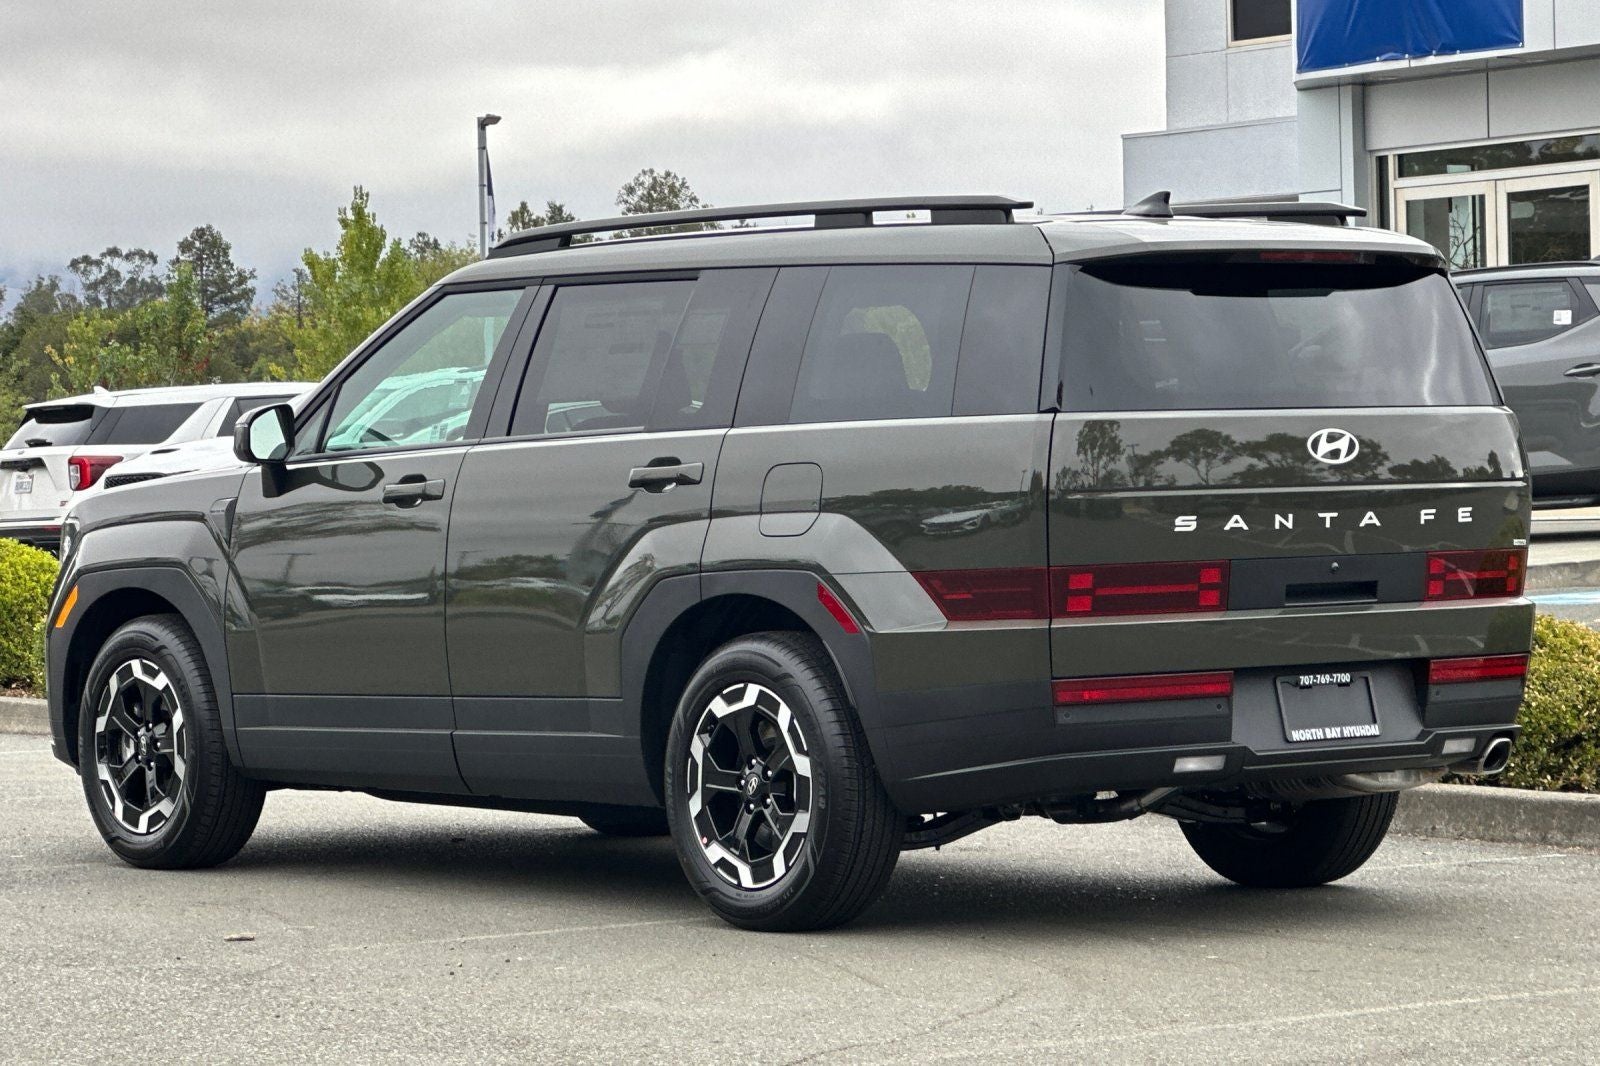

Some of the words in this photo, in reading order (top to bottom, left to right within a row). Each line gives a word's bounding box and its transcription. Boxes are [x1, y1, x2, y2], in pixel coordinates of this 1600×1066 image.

[1174, 511, 1382, 532] SANTA
[1420, 506, 1473, 525] FE
[1299, 673, 1351, 685] 707-769-7700
[1291, 728, 1324, 741] NORTH
[1325, 726, 1341, 739] BAY
[1343, 724, 1380, 738] HYUNDAI
